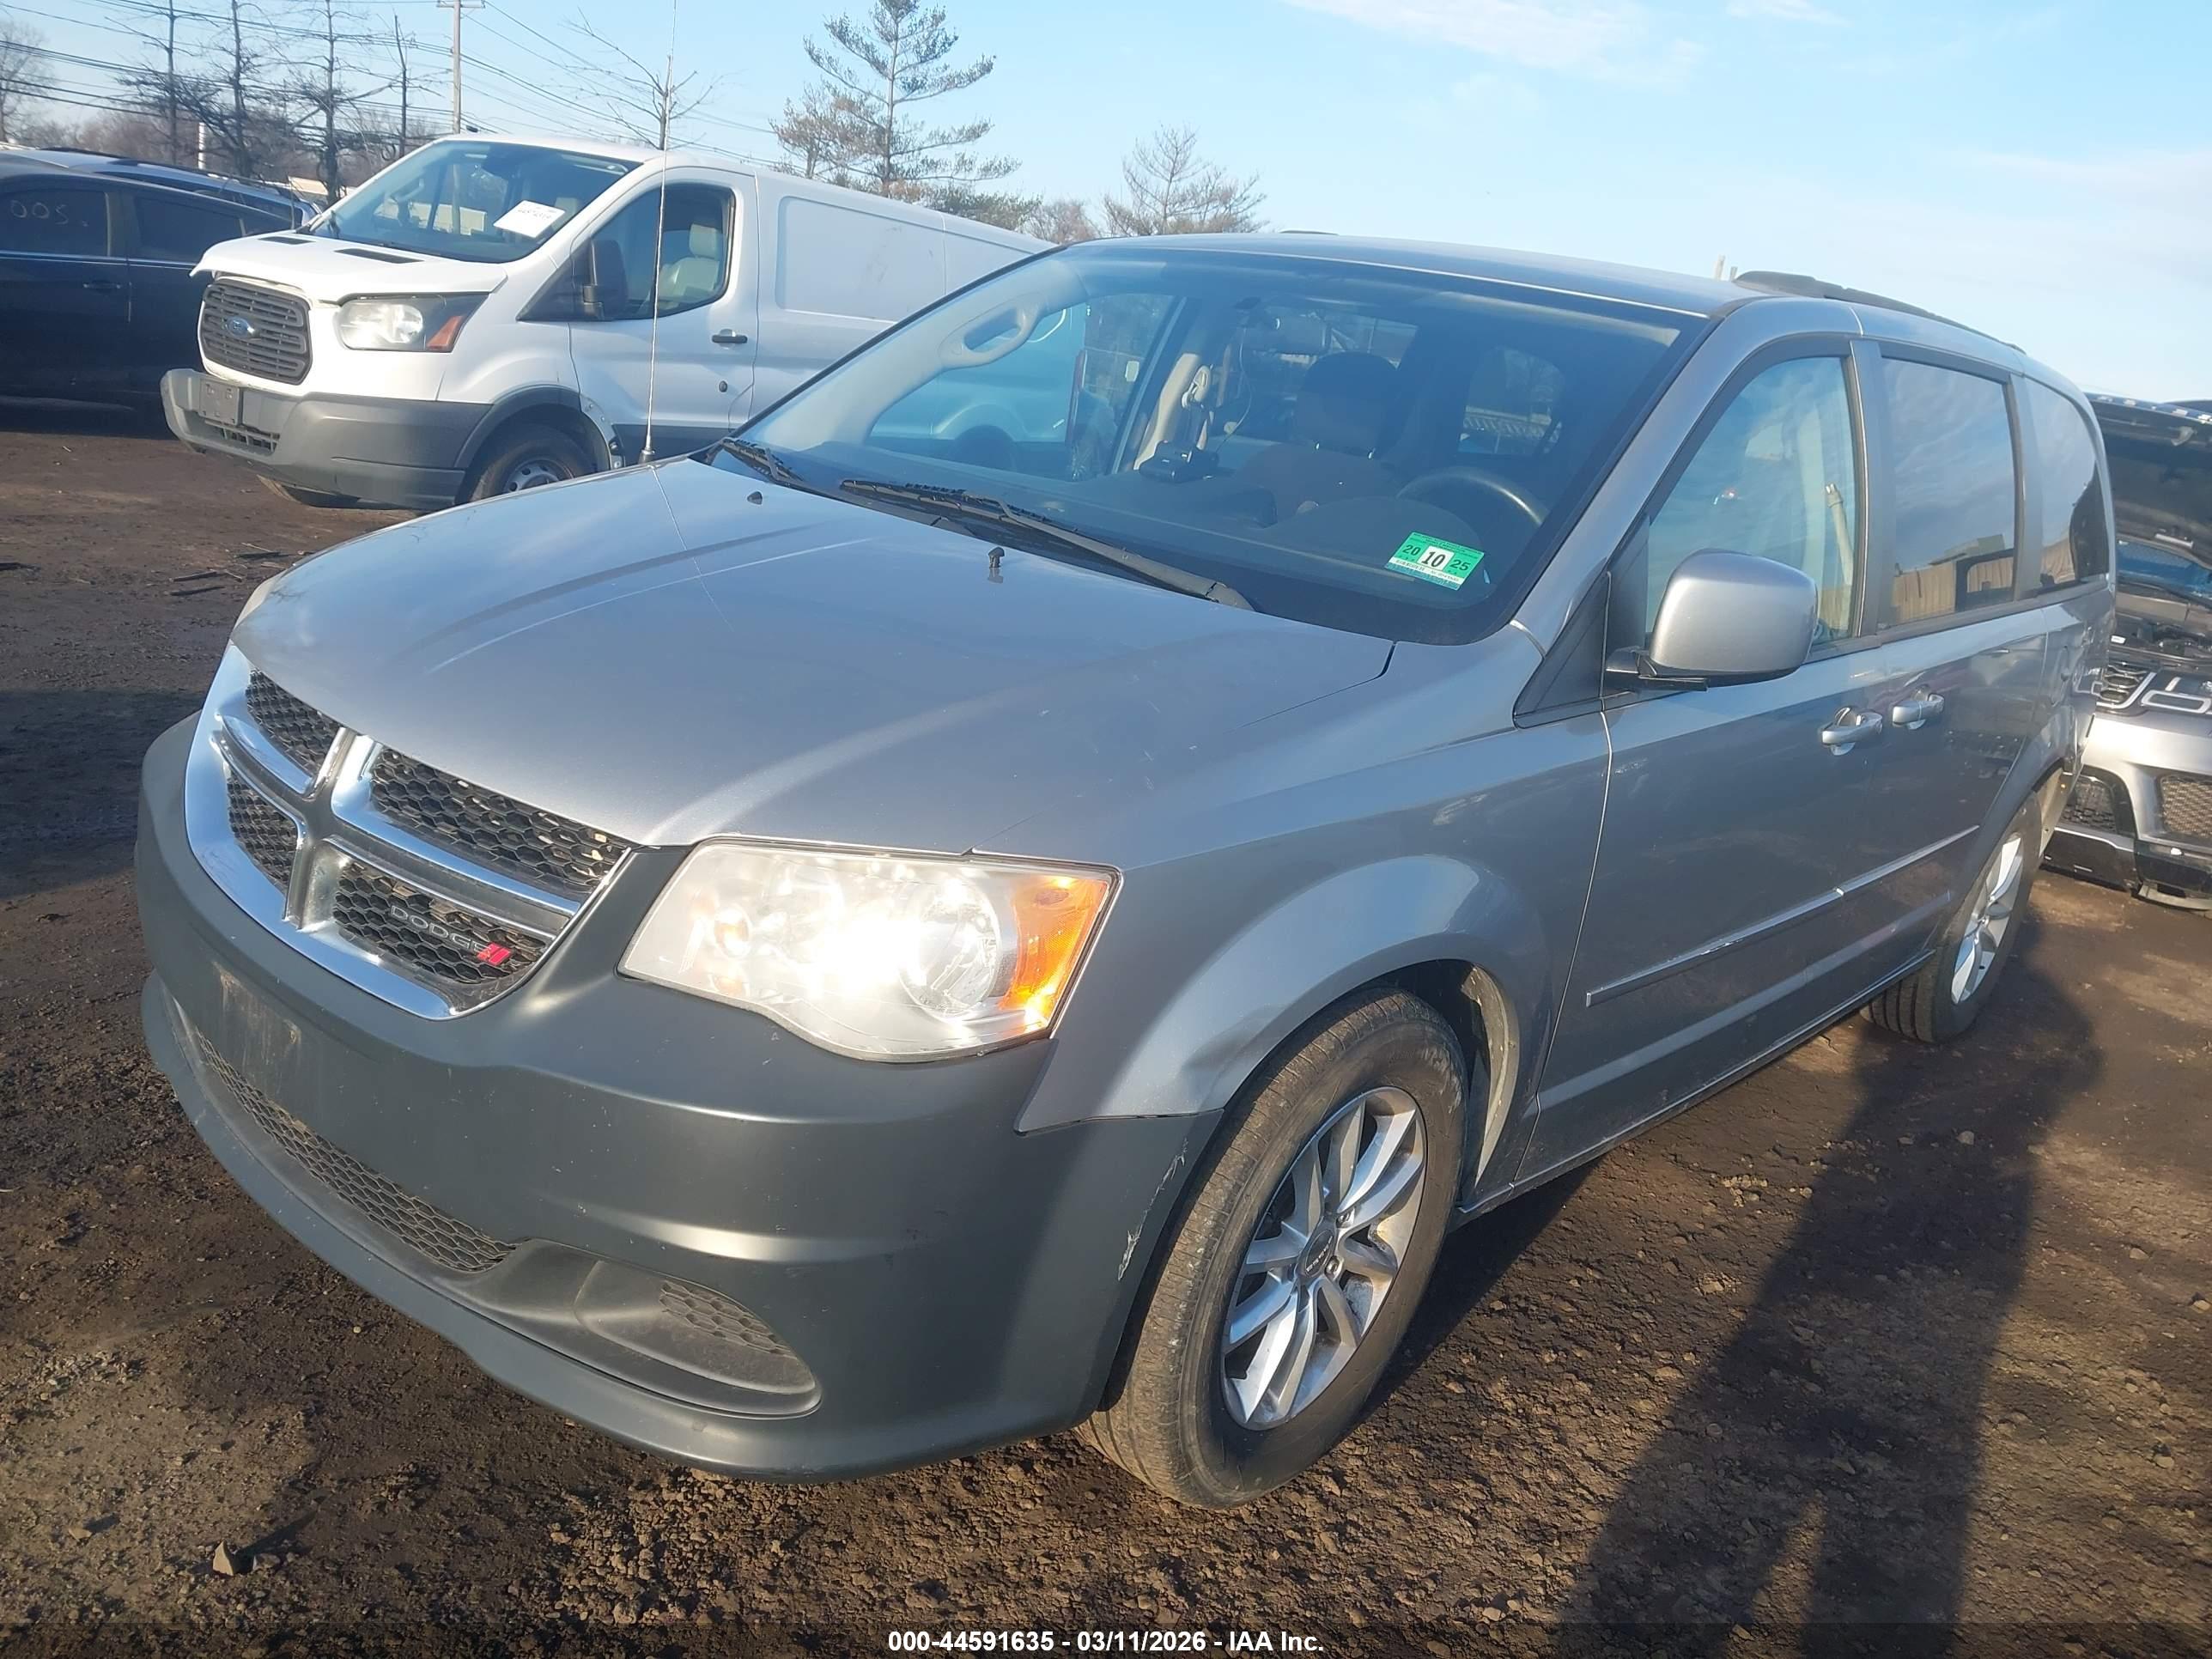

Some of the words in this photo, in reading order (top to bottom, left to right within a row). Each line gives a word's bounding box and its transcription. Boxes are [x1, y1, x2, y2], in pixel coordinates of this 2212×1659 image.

[1402, 544, 1421, 556] 20
[1421, 550, 1446, 568] 10
[1449, 559, 1471, 571] 25
[391, 905, 491, 953] DODGE
